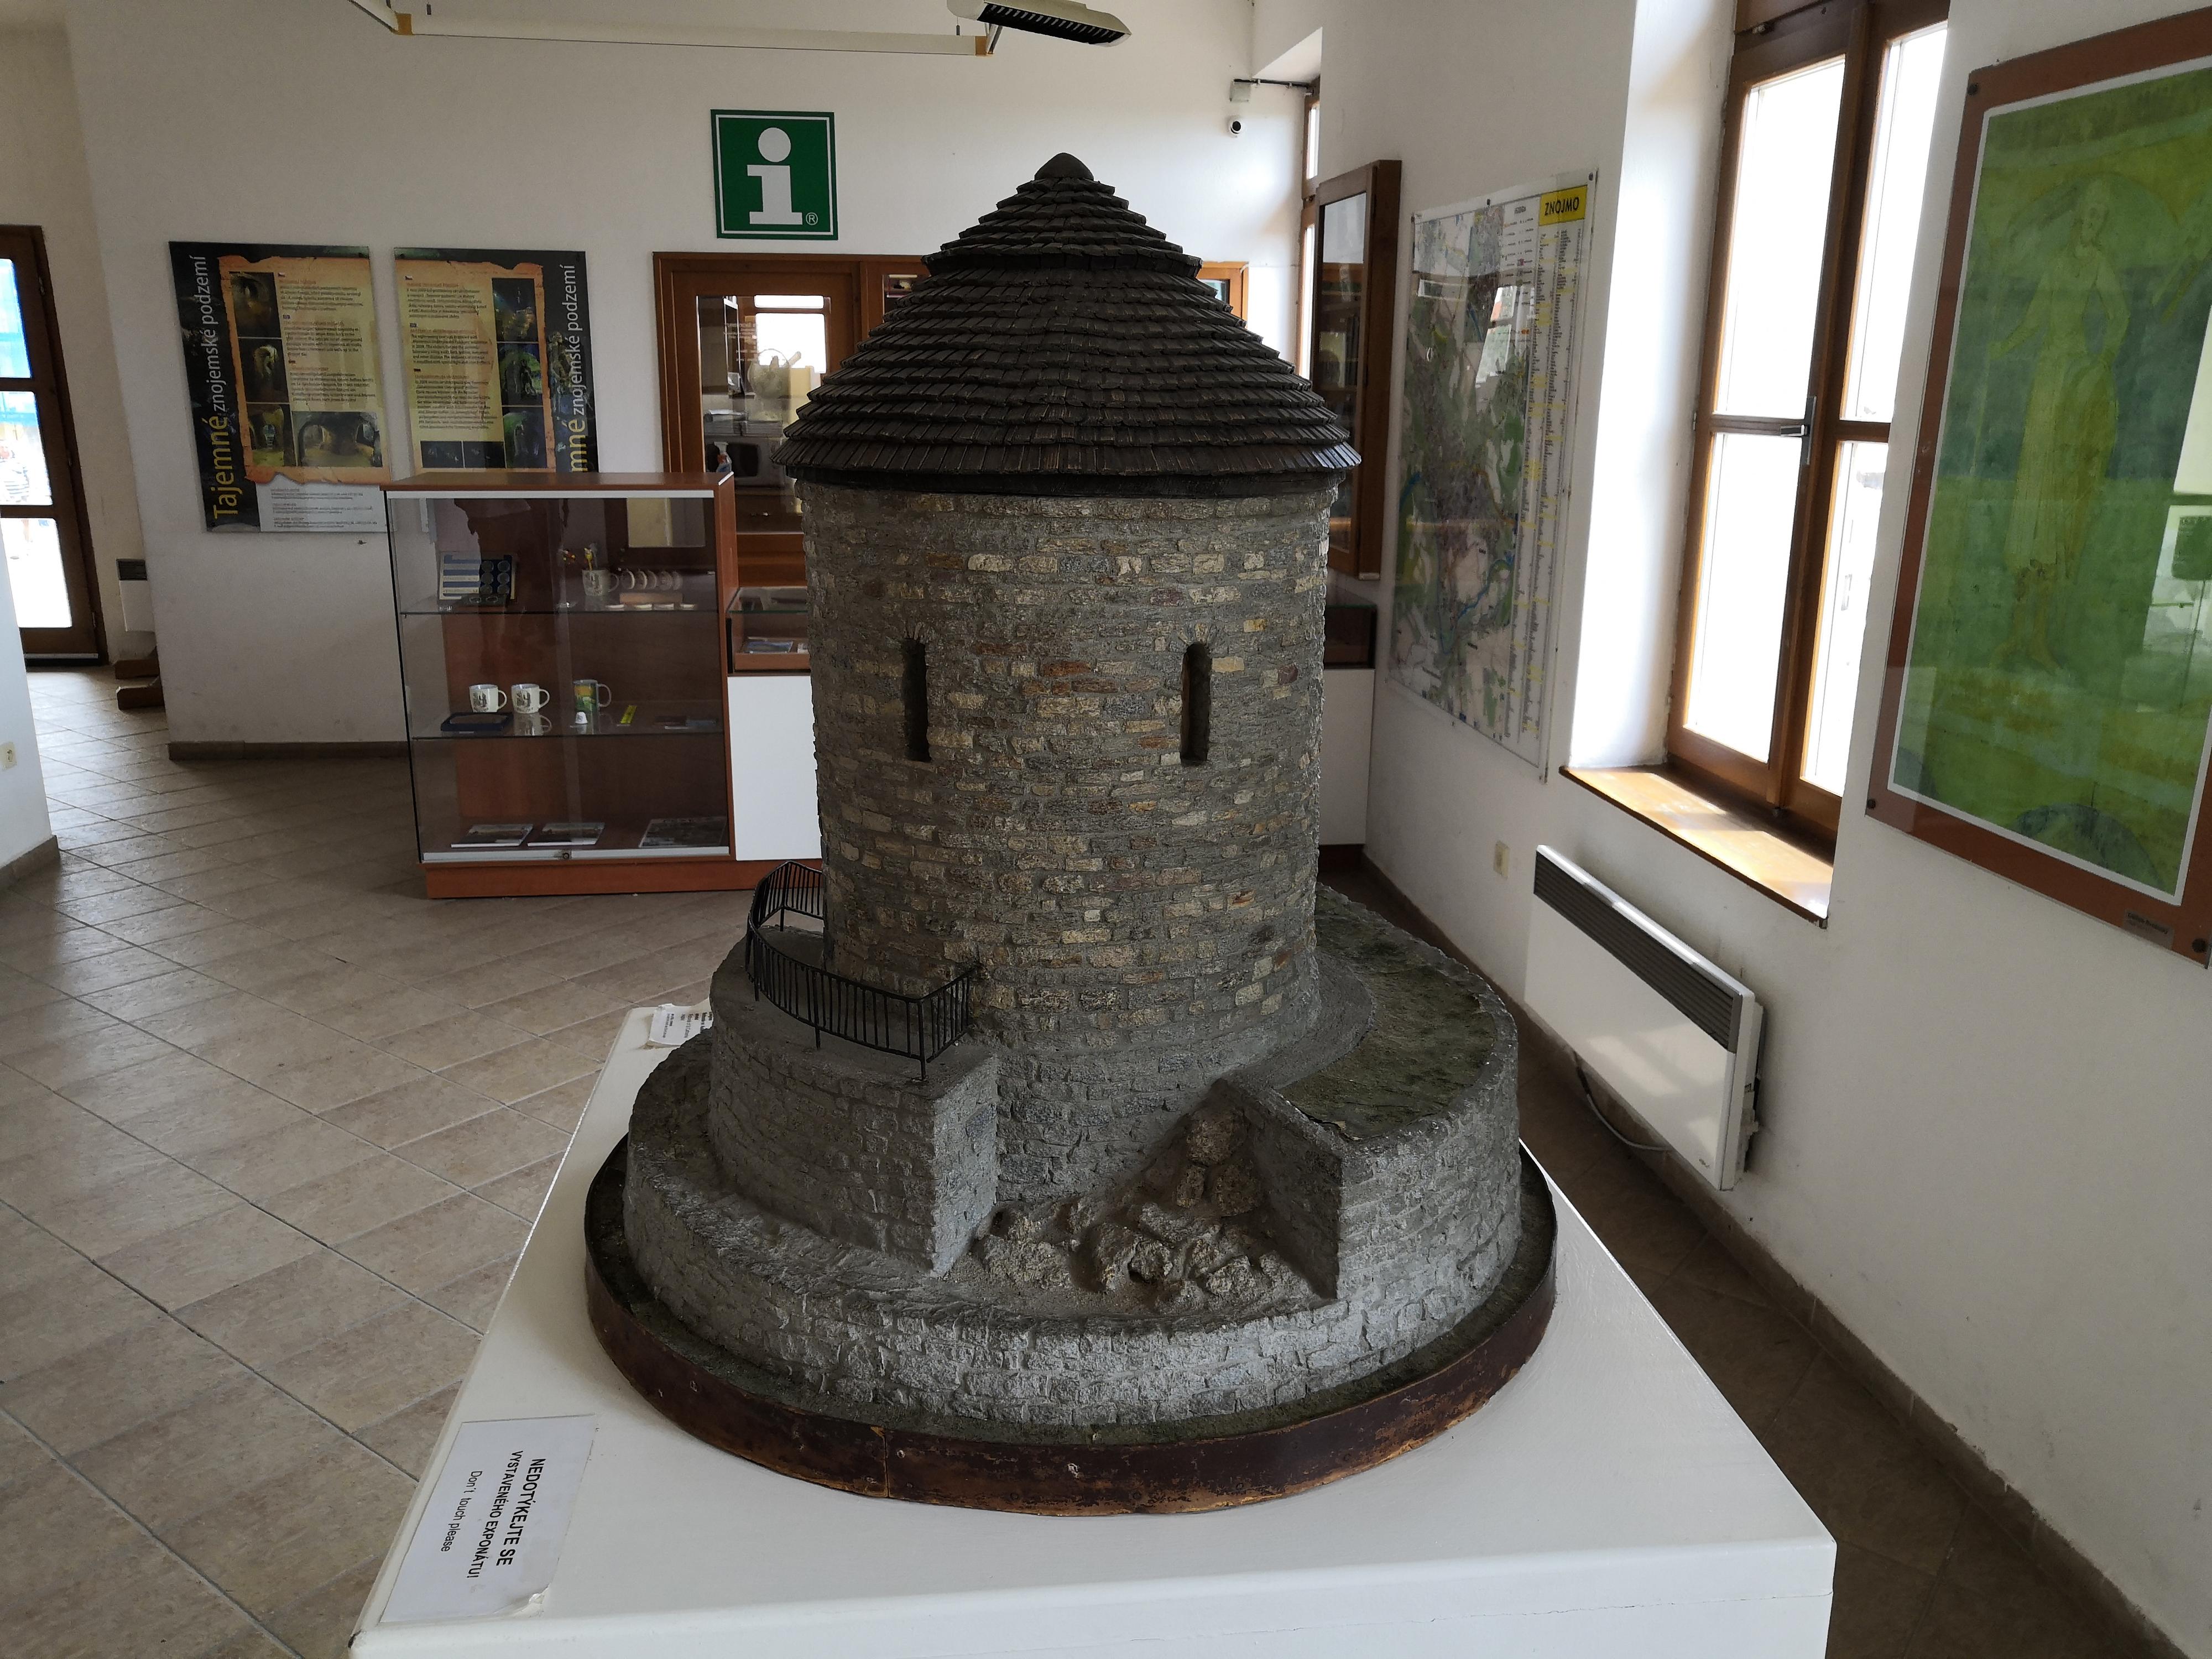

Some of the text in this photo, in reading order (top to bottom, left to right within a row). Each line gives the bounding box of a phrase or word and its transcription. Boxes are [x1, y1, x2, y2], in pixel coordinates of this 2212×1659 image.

[1545, 197, 1579, 216] ZNOJMO
[559, 264, 583, 332] podzemí
[189, 255, 243, 519] Tajemné znojemské podzemí
[565, 335, 587, 416] znojemské
[441, 1470, 483, 1552] Don't touch please
[467, 1451, 524, 1578] VYSTAVENÉHO EXPONÁTU!
[496, 1458, 546, 1566] NEDOTÝKEJTE SE
